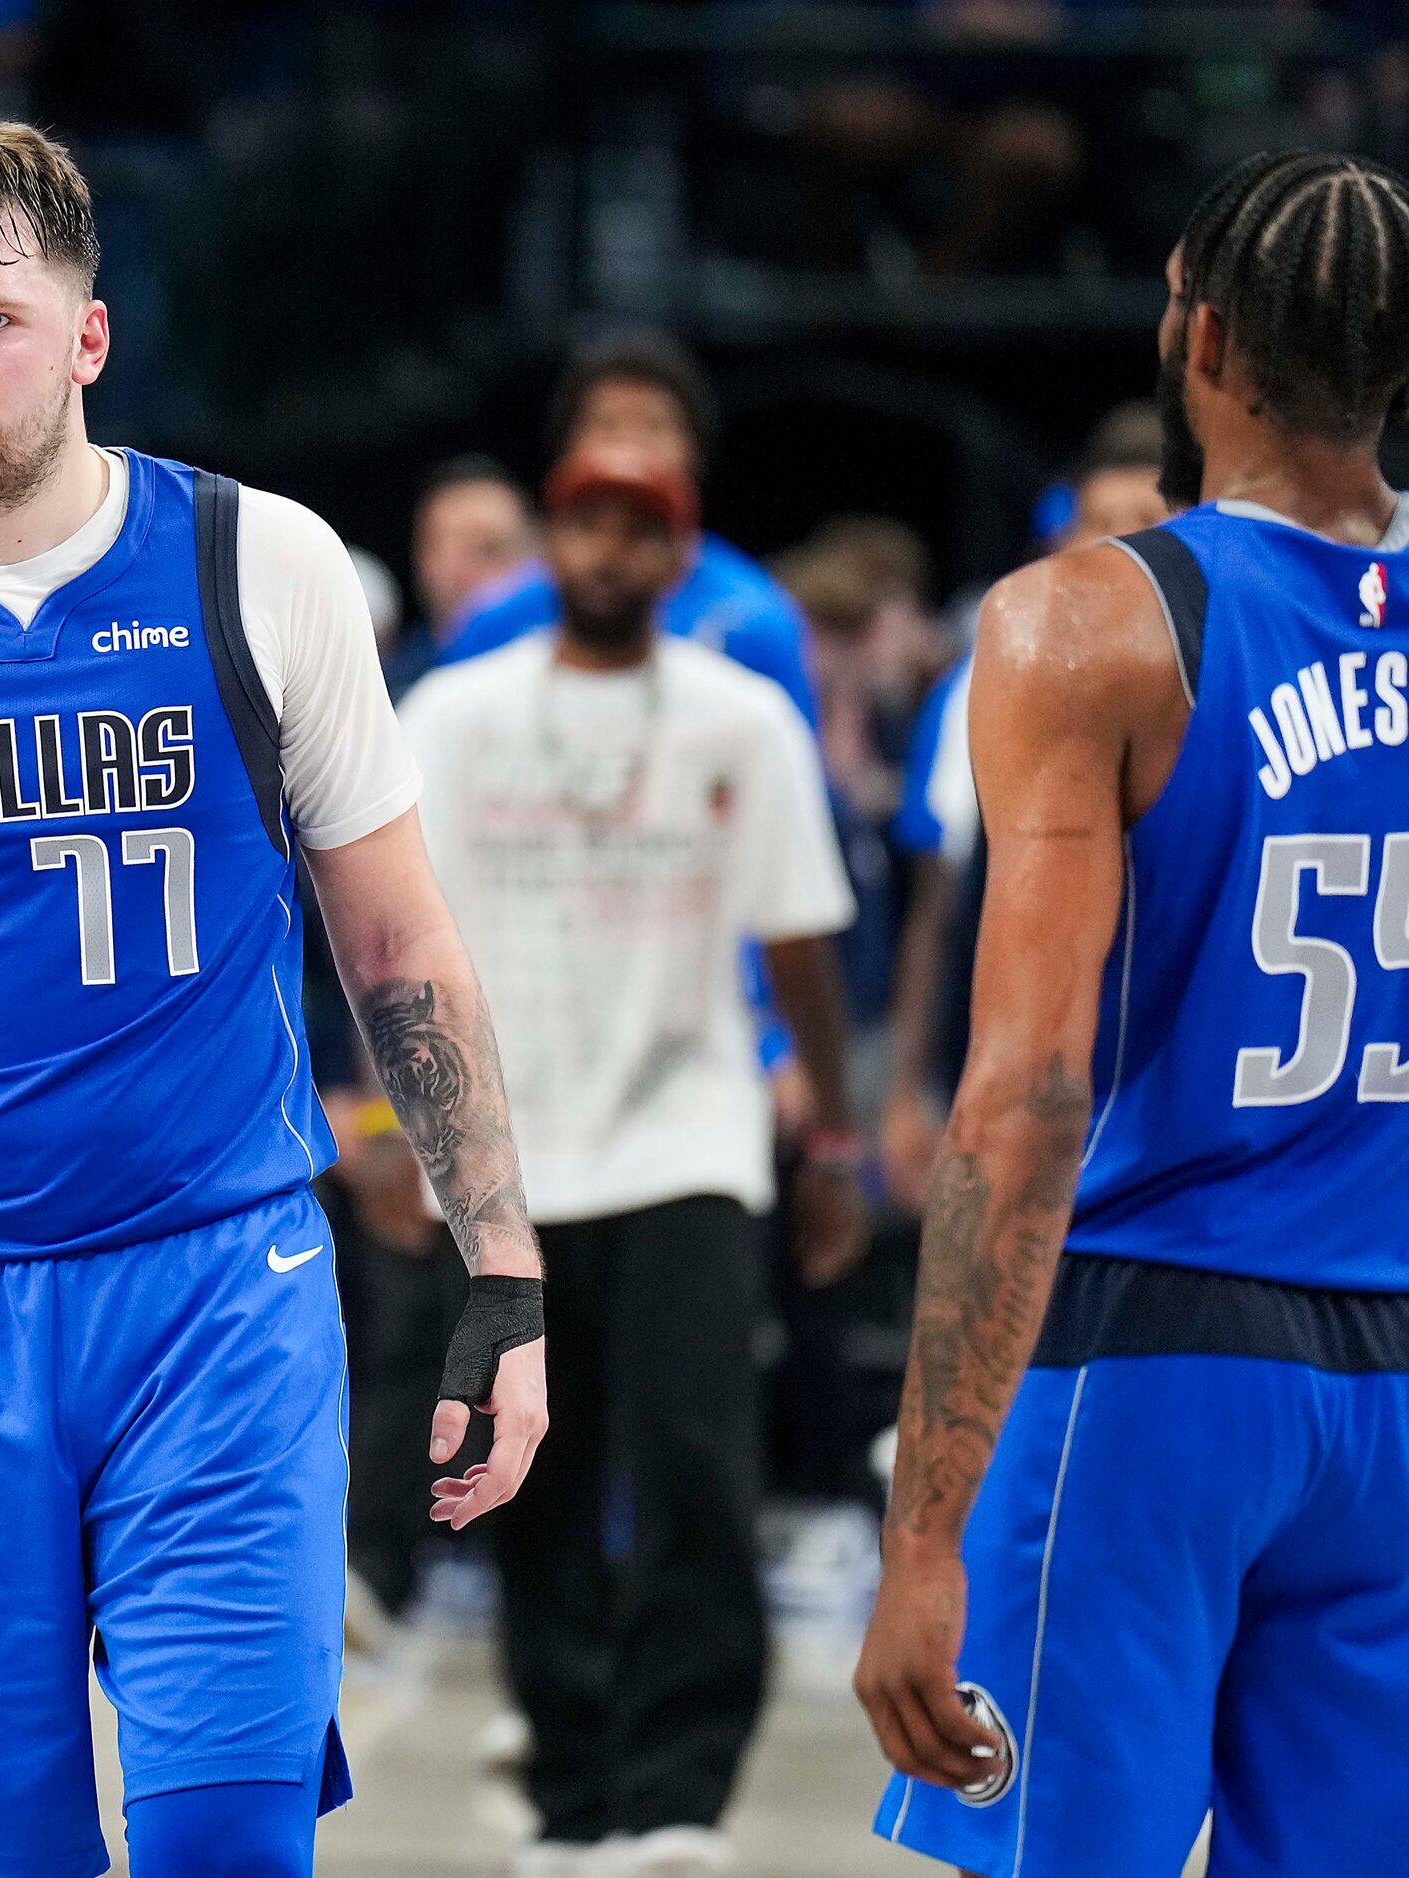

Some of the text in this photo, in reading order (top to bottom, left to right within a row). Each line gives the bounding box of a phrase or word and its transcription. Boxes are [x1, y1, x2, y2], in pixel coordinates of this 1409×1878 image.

[92, 620, 190, 653] chime
[1248, 650, 1409, 800] JONES
[30, 827, 200, 987] 77
